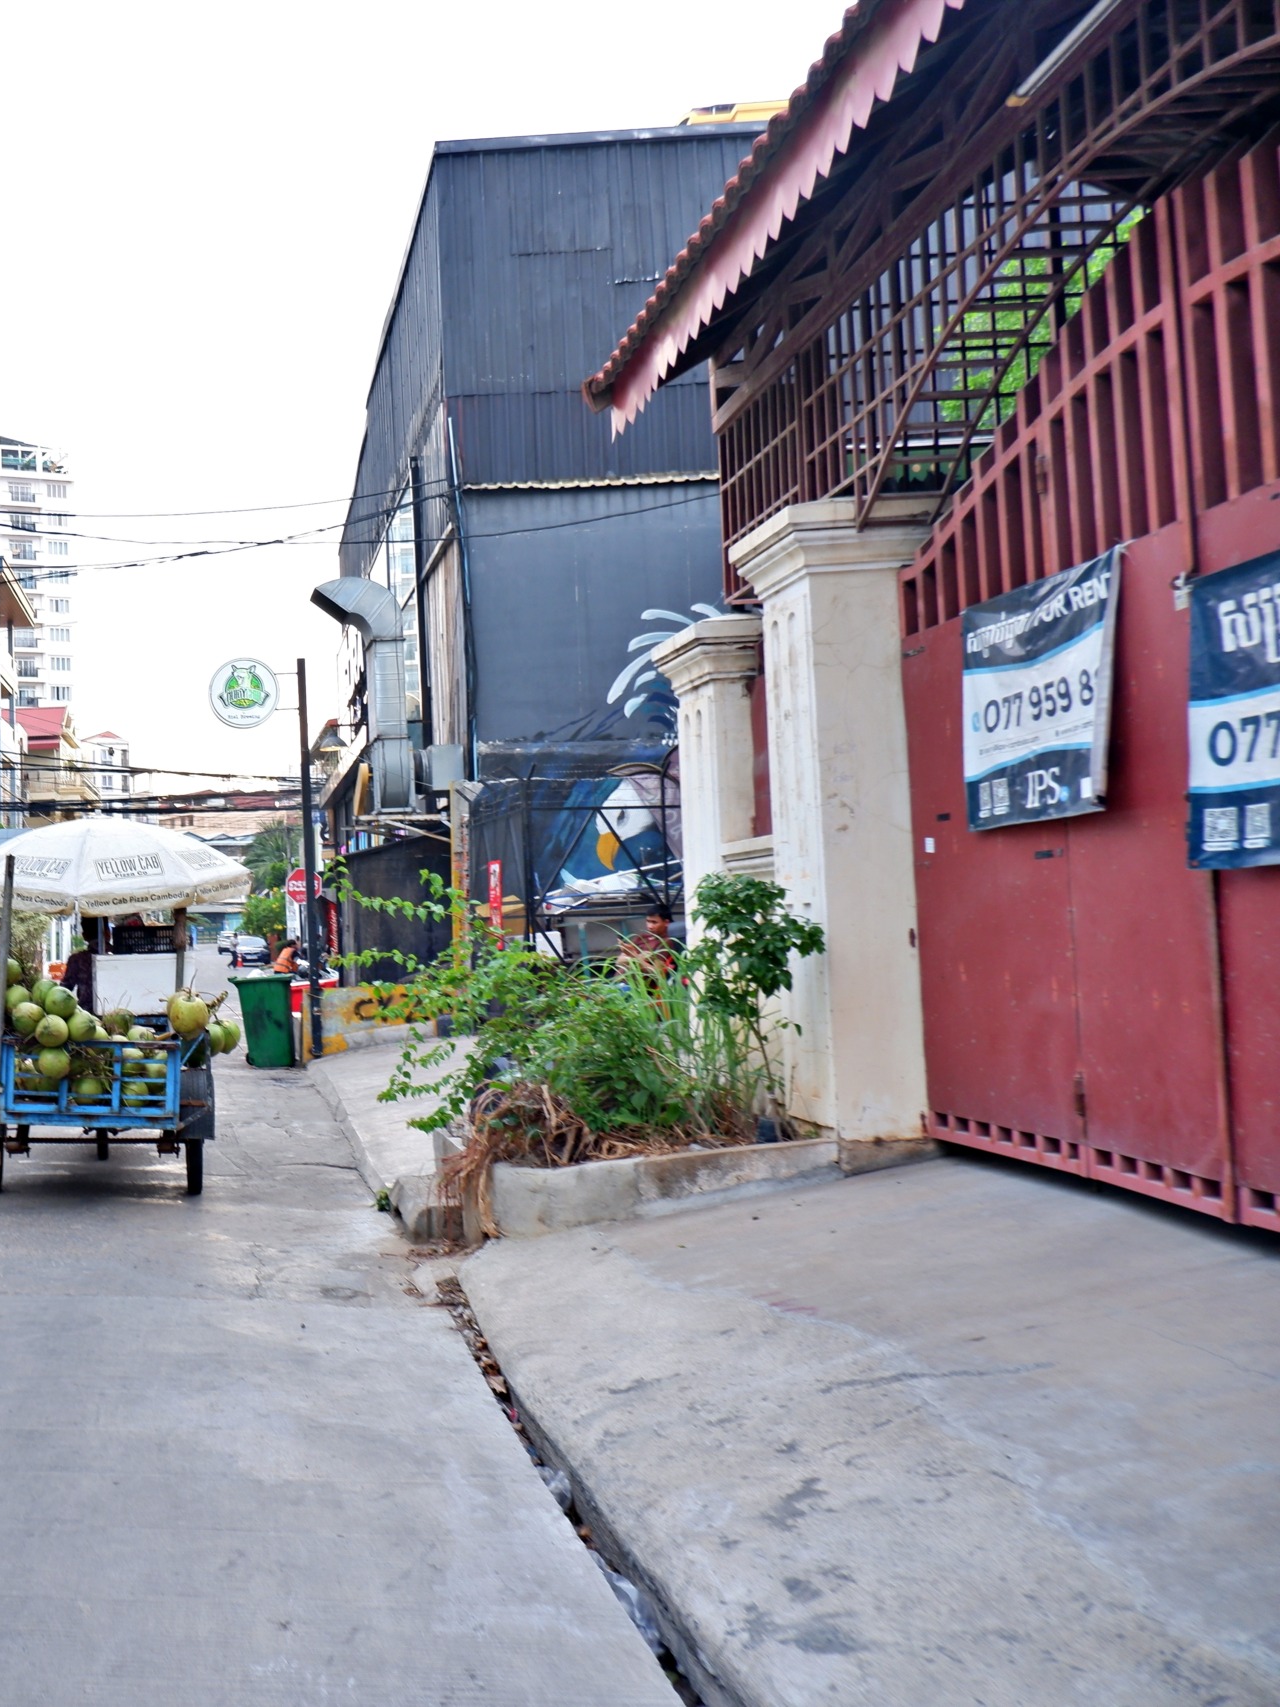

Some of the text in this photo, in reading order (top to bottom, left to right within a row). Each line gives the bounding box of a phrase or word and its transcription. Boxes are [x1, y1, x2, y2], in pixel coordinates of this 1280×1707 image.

[984, 691, 1023, 733] 077
[1029, 676, 1072, 721] 959
[1079, 668, 1099, 706] 8
[1208, 709, 1280, 767] 077
[1025, 767, 1061, 809] IPS
[97, 857, 138, 875] YELLOW
[138, 853, 160, 871] CAB
[85, 891, 190, 909] Yellow Cab Pizza Cambodia
